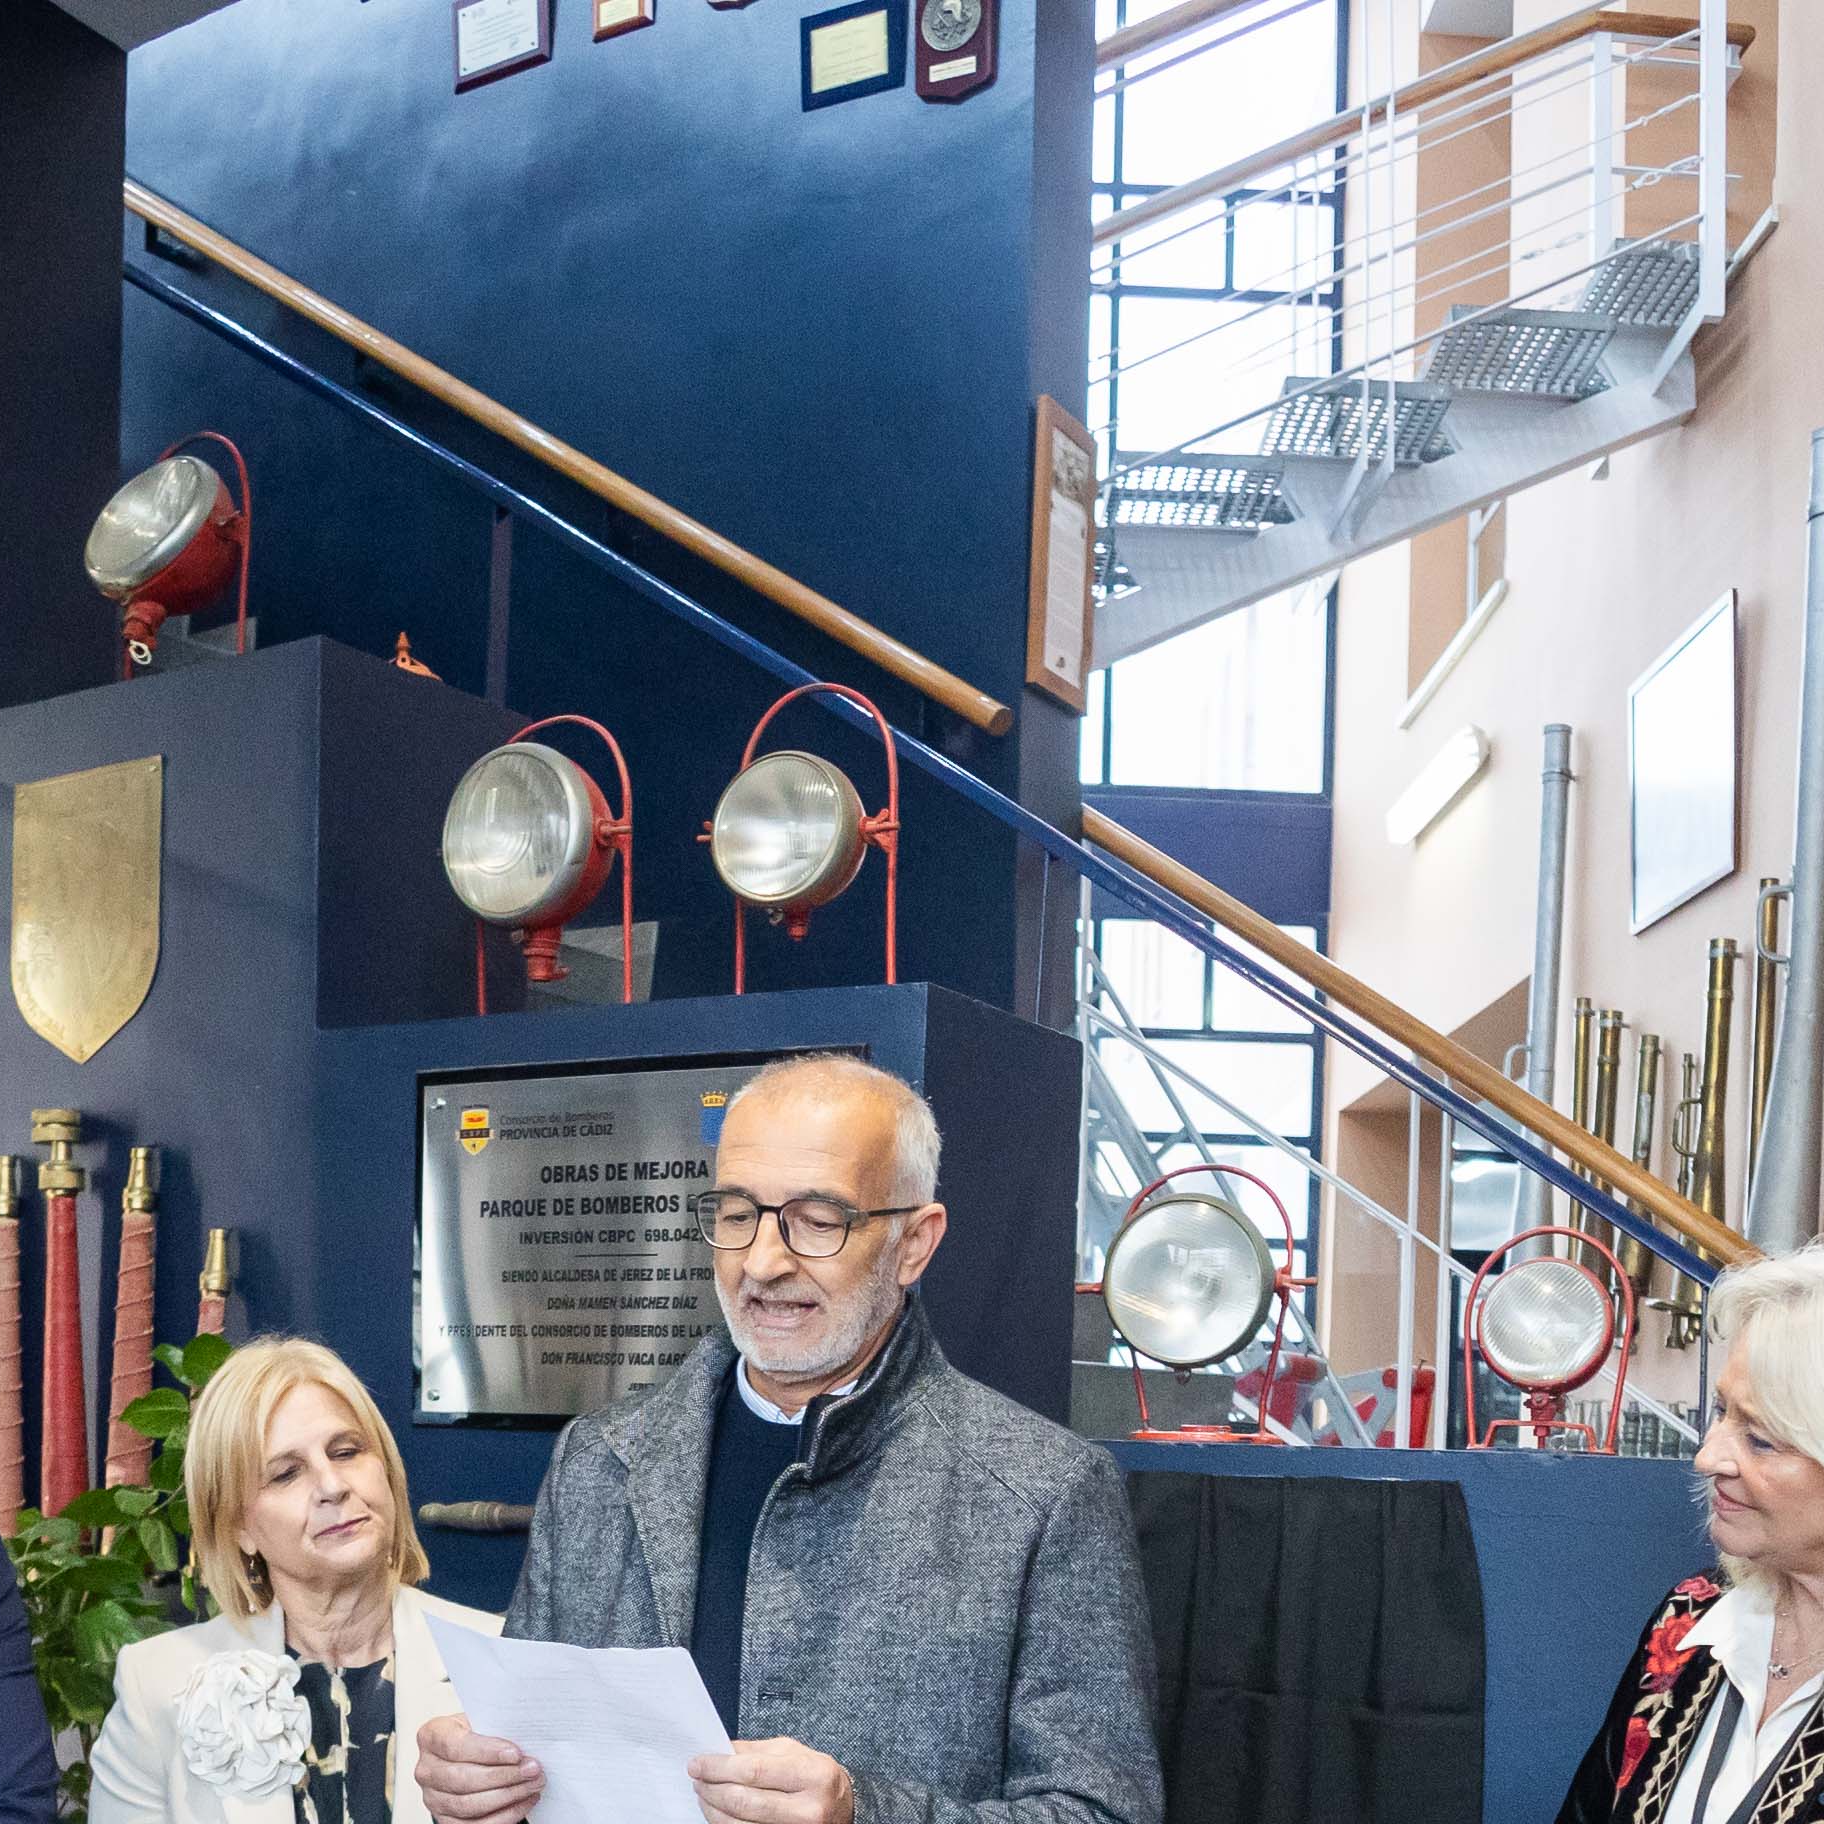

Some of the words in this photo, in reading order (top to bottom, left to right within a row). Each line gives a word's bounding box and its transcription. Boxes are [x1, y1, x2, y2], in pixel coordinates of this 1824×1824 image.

[499, 1127, 560, 1141] PROVINCIA
[563, 1126, 578, 1139] DE
[580, 1123, 614, 1138] CÁDIZ
[540, 1165, 599, 1184] OBRAS
[604, 1163, 629, 1182] DE
[633, 1160, 710, 1181] MEJORA
[479, 1199, 547, 1218] PARQUE
[552, 1198, 575, 1216] DE
[580, 1194, 680, 1216] BOMBEROS
[598, 1229, 636, 1243] CBPC
[644, 1227, 703, 1244] 698.042,
[501, 1269, 540, 1283] SIENDO
[542, 1268, 601, 1283] ALCALDESA
[603, 1268, 618, 1282] DE
[620, 1268, 654, 1281] JEREZ
[656, 1268, 671, 1281] DE
[673, 1267, 687, 1281] LA
[578, 1297, 618, 1310] MAMEN
[620, 1294, 669, 1309] SÁNCHEZ
[672, 1294, 698, 1310] DÍAZ
[447, 1325, 507, 1337] PRESIDENTE
[509, 1325, 528, 1337] DEL
[530, 1325, 591, 1338] CONSORCIO
[593, 1325, 608, 1337] DE
[610, 1325, 669, 1338] BOMBEROS
[672, 1325, 686, 1338] DE
[688, 1325, 703, 1338] LA
[541, 1352, 564, 1366] DON
[566, 1352, 625, 1366] FRANCISCO
[628, 1352, 655, 1366] VACA
